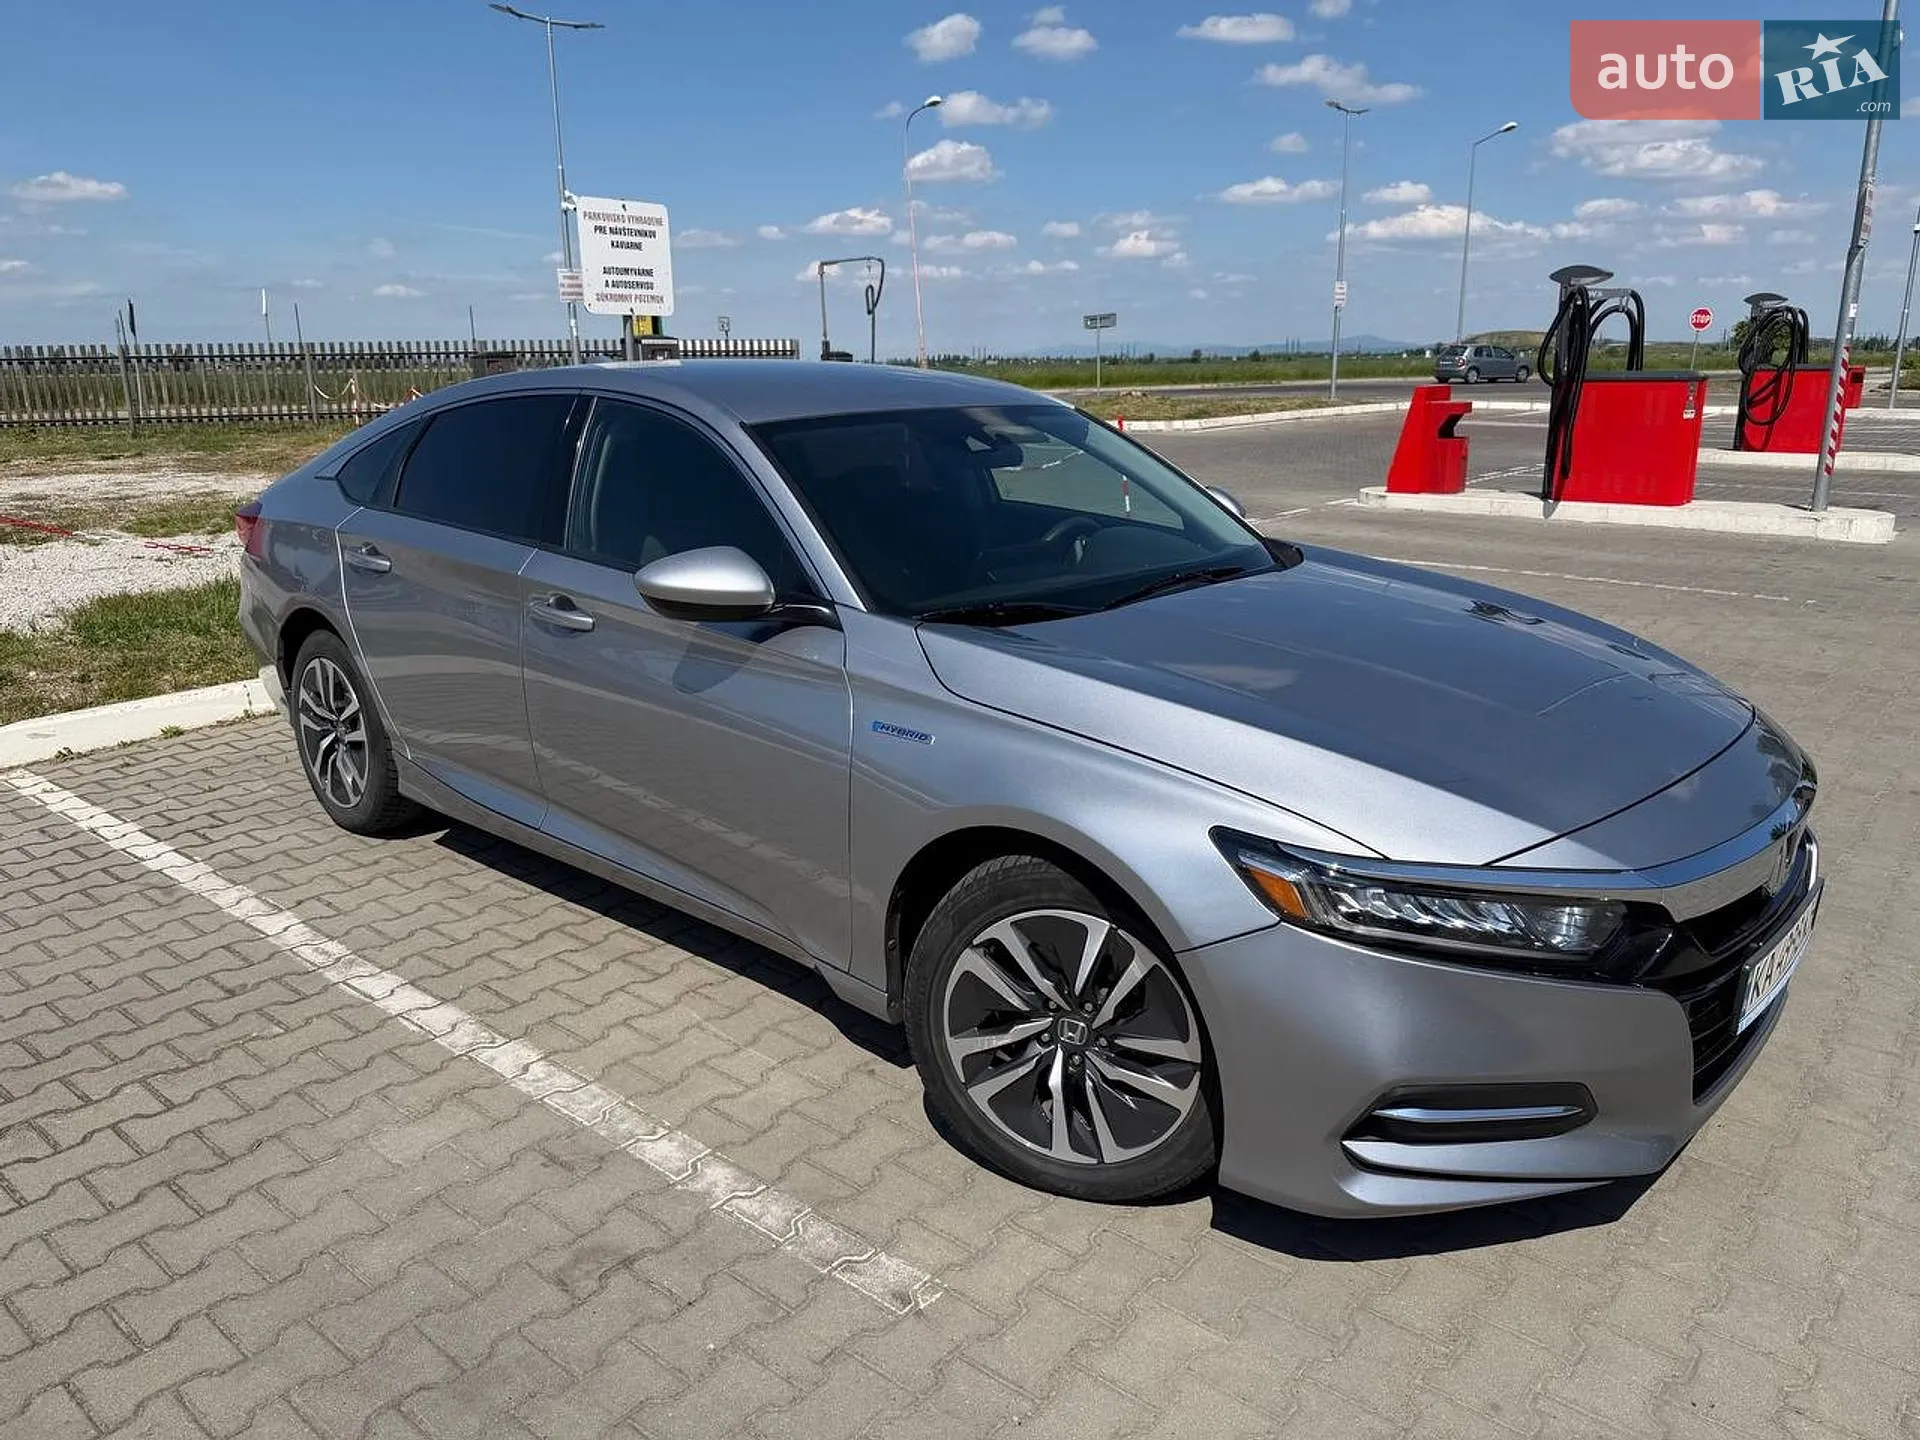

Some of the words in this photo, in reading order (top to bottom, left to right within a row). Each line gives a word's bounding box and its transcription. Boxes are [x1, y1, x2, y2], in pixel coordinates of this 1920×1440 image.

[594, 225, 607, 235] PRE
[605, 279, 610, 289] A
[1692, 314, 1710, 324] STOP
[879, 723, 931, 741] HYBRID
